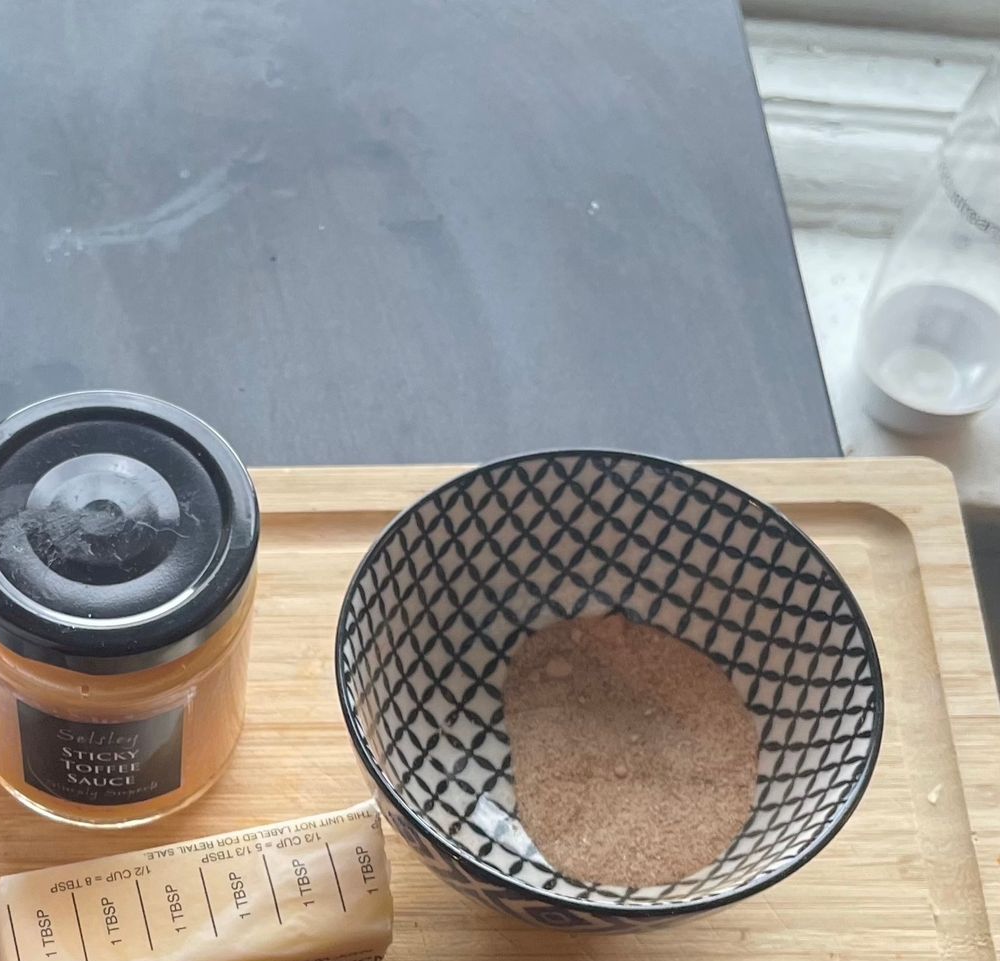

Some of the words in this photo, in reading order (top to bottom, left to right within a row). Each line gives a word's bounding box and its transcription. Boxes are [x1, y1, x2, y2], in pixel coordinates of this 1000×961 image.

[62, 746, 141, 763] STICKY
[60, 758, 140, 774] TOFFEE
[67, 773, 136, 787] SAUCE
[319, 816, 344, 827] UNIT
[347, 809, 372, 822] THIS
[294, 821, 318, 831] NOT
[216, 834, 240, 846] FOR
[242, 826, 291, 841] LABELED
[305, 831, 322, 844] 1/3
[180, 841, 214, 854] RETAIL
[255, 842, 263, 852] 5
[276, 836, 301, 849] CUP
[143, 848, 175, 860] SALE.
[236, 844, 252, 857] 1/3
[201, 851, 233, 864] TBSP
[135, 864, 151, 877] 1/2
[356, 845, 375, 884] TBSP
[85, 876, 92, 886] 8
[106, 869, 132, 882] CUP
[292, 858, 312, 896] TBSP
[50, 879, 83, 893] TBSP
[229, 871, 248, 909] TBSP
[165, 884, 184, 922] TBSP
[101, 897, 120, 935] TBSP
[36, 909, 55, 947] TBSP
